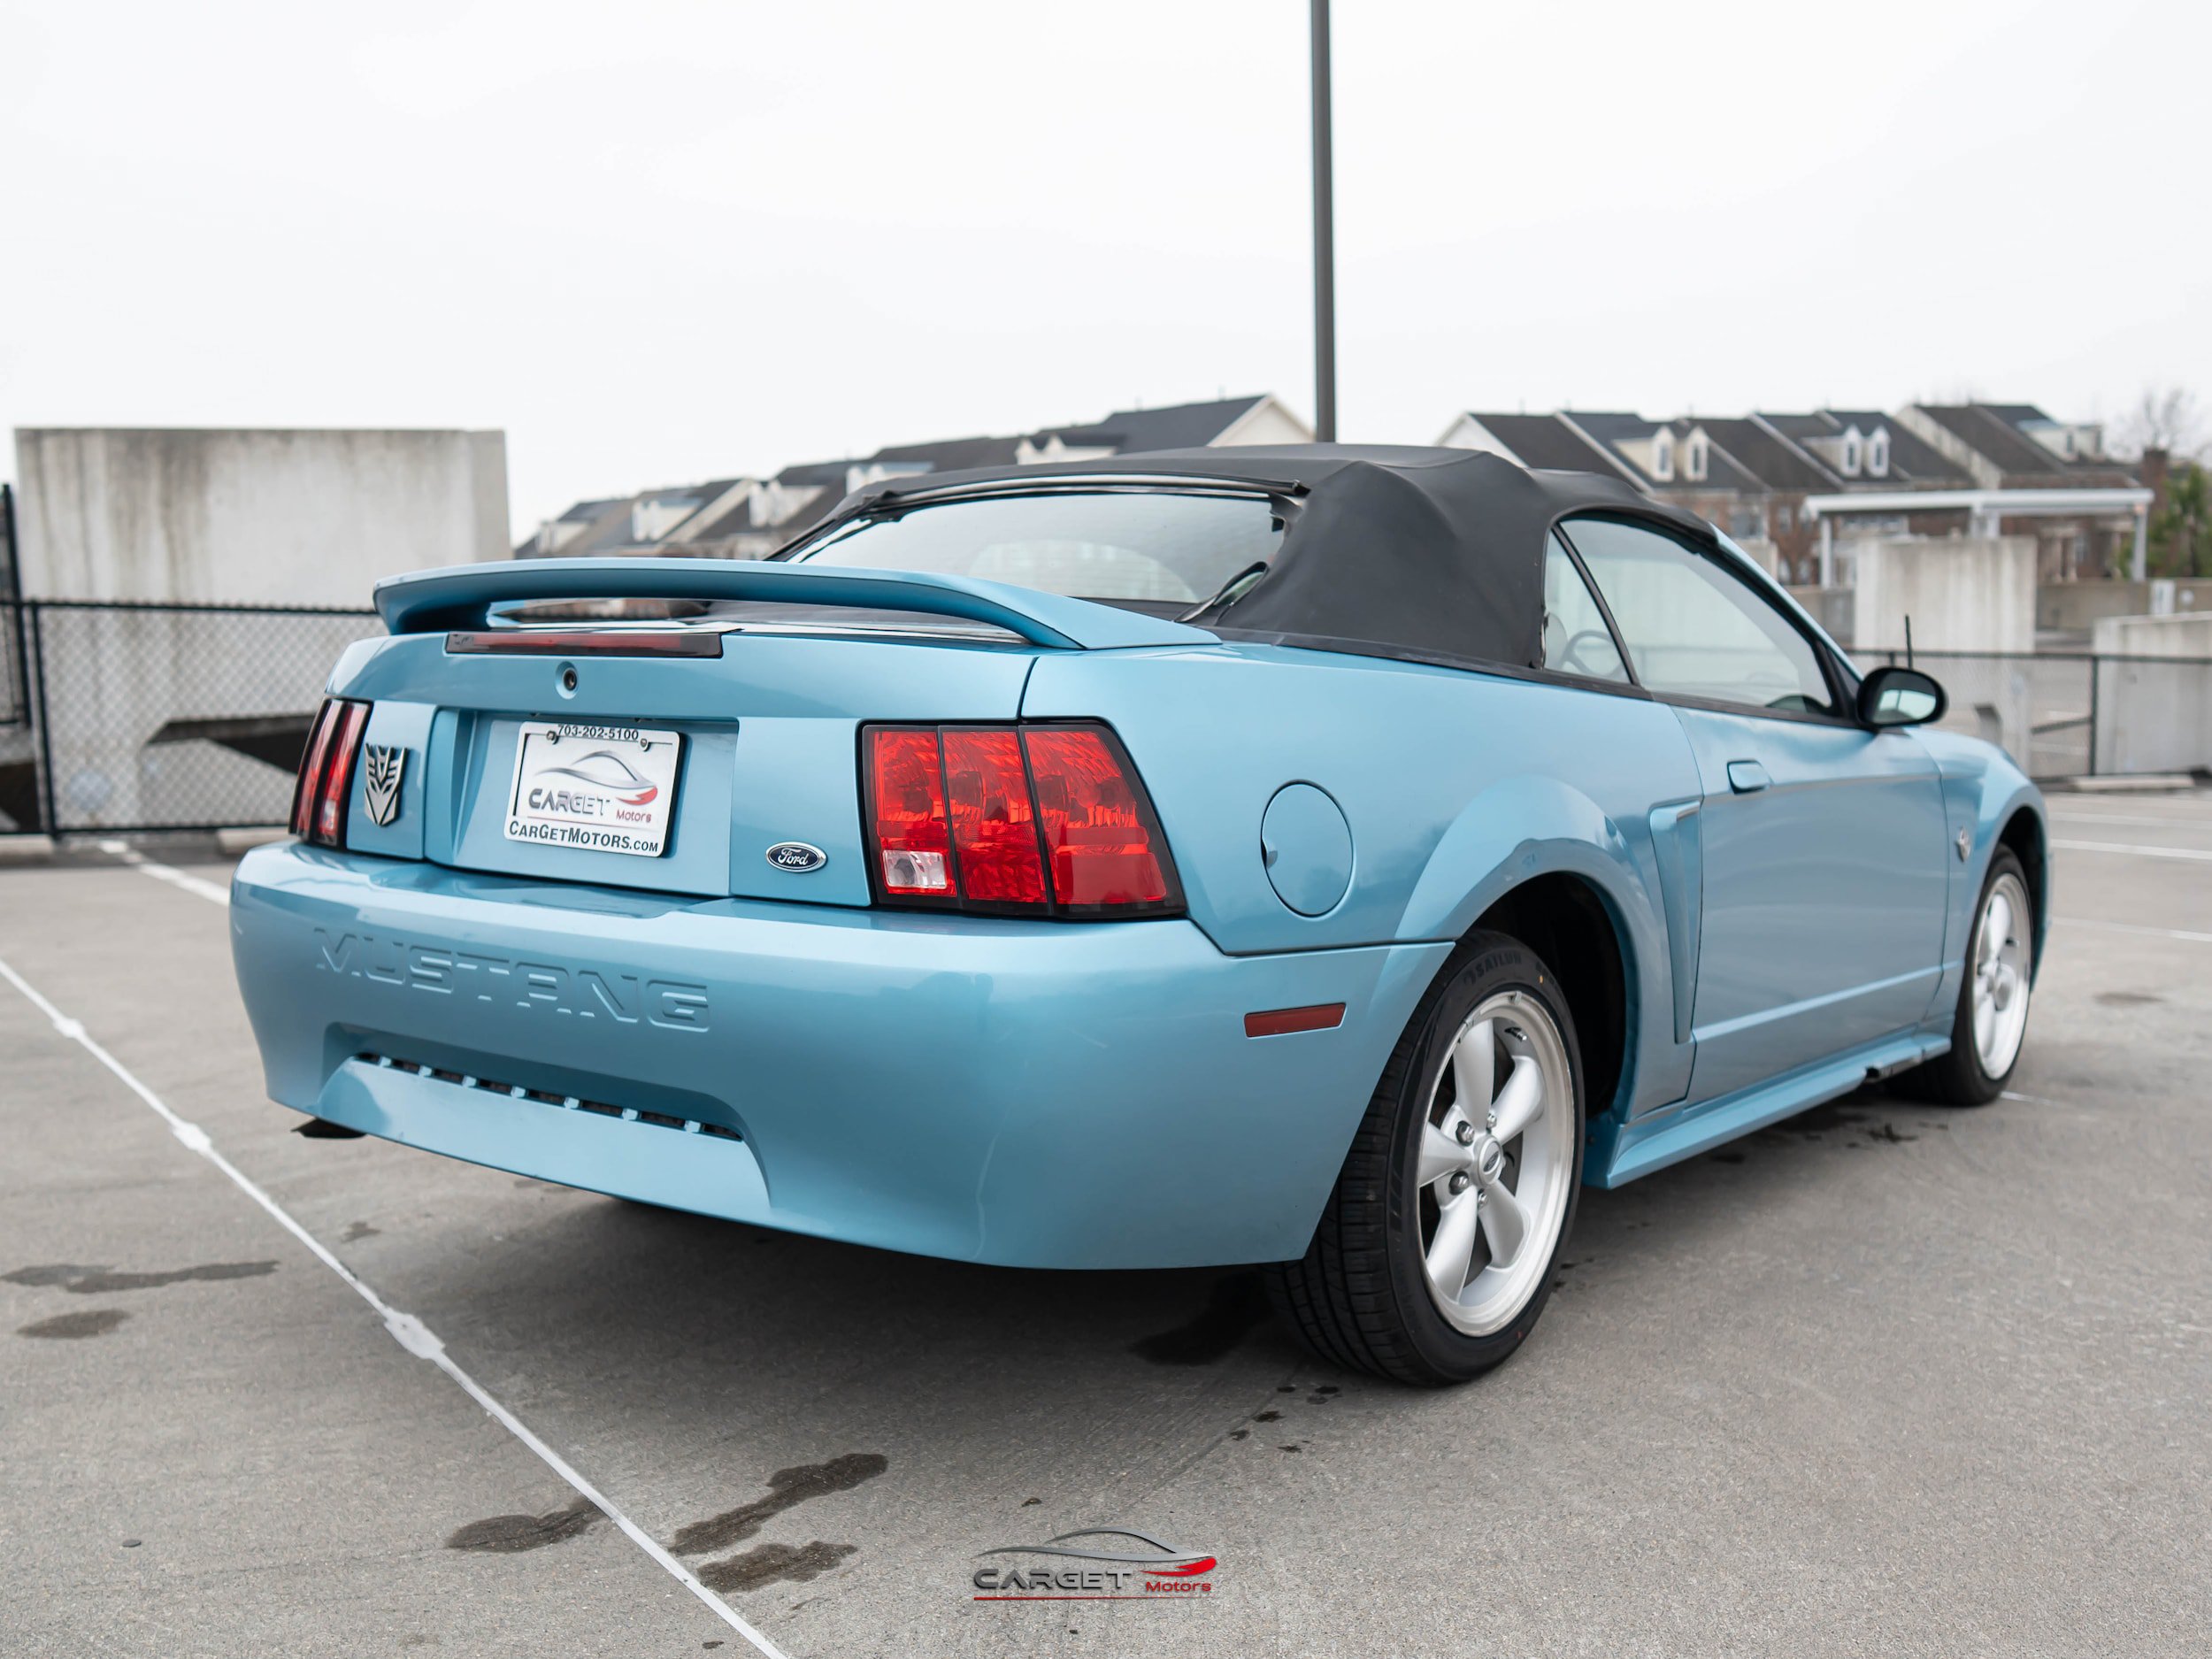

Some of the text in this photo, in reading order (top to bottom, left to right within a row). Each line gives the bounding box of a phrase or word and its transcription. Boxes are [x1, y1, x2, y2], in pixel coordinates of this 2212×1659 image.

[557, 723, 640, 741] 703-202-5100
[528, 787, 611, 816] CARGET
[615, 809, 652, 824] Motors
[777, 847, 810, 865] Ford
[313, 926, 710, 1033] MUSTANG
